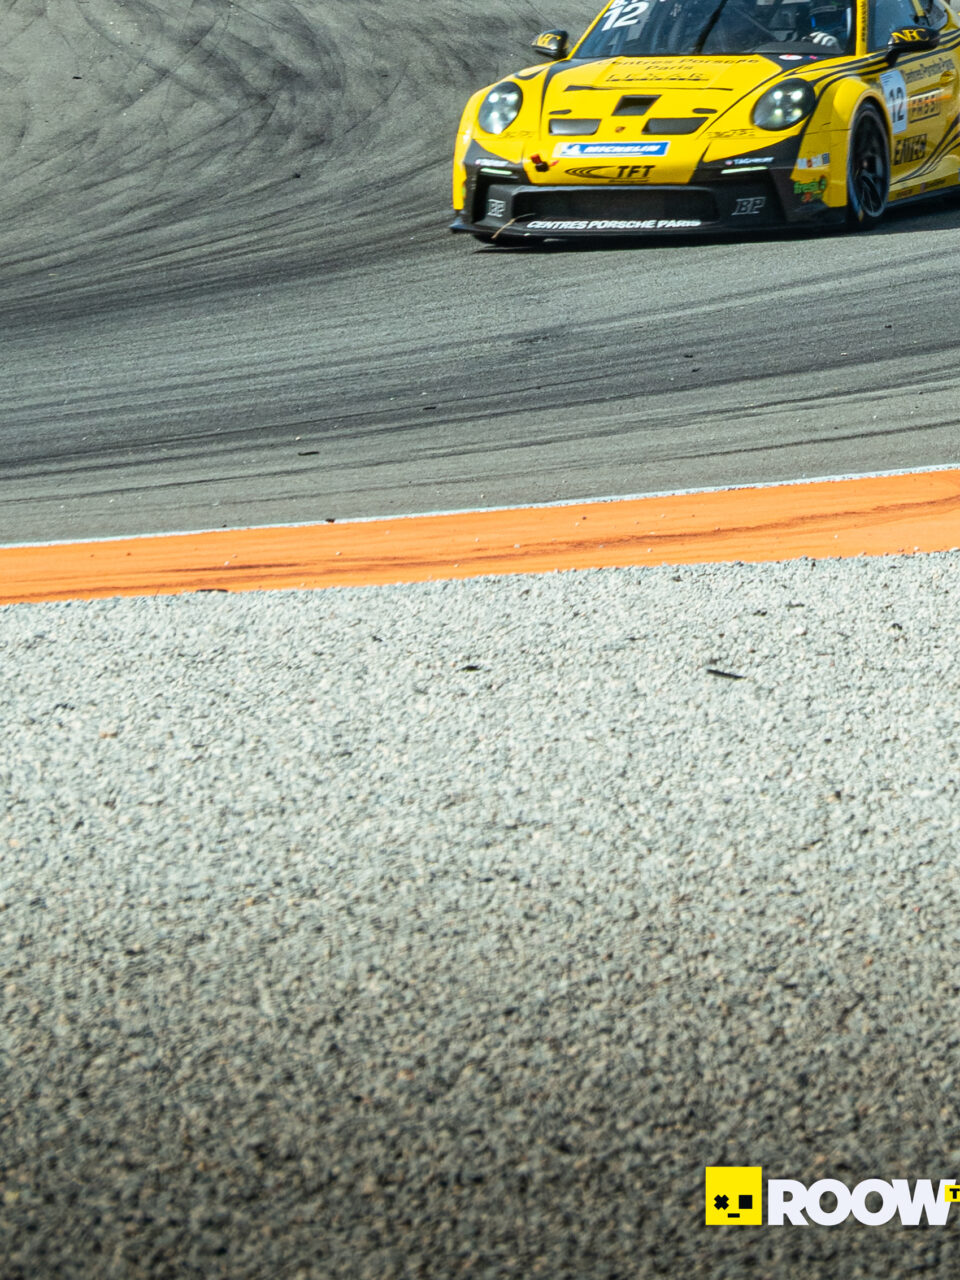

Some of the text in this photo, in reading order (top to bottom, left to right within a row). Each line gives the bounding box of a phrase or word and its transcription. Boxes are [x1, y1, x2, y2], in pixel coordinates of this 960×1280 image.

[601, 1, 650, 32] 12
[889, 86, 905, 124] 12
[617, 164, 656, 178] TFT
[527, 220, 589, 230] CENTRES
[587, 219, 657, 229] PORSCHE
